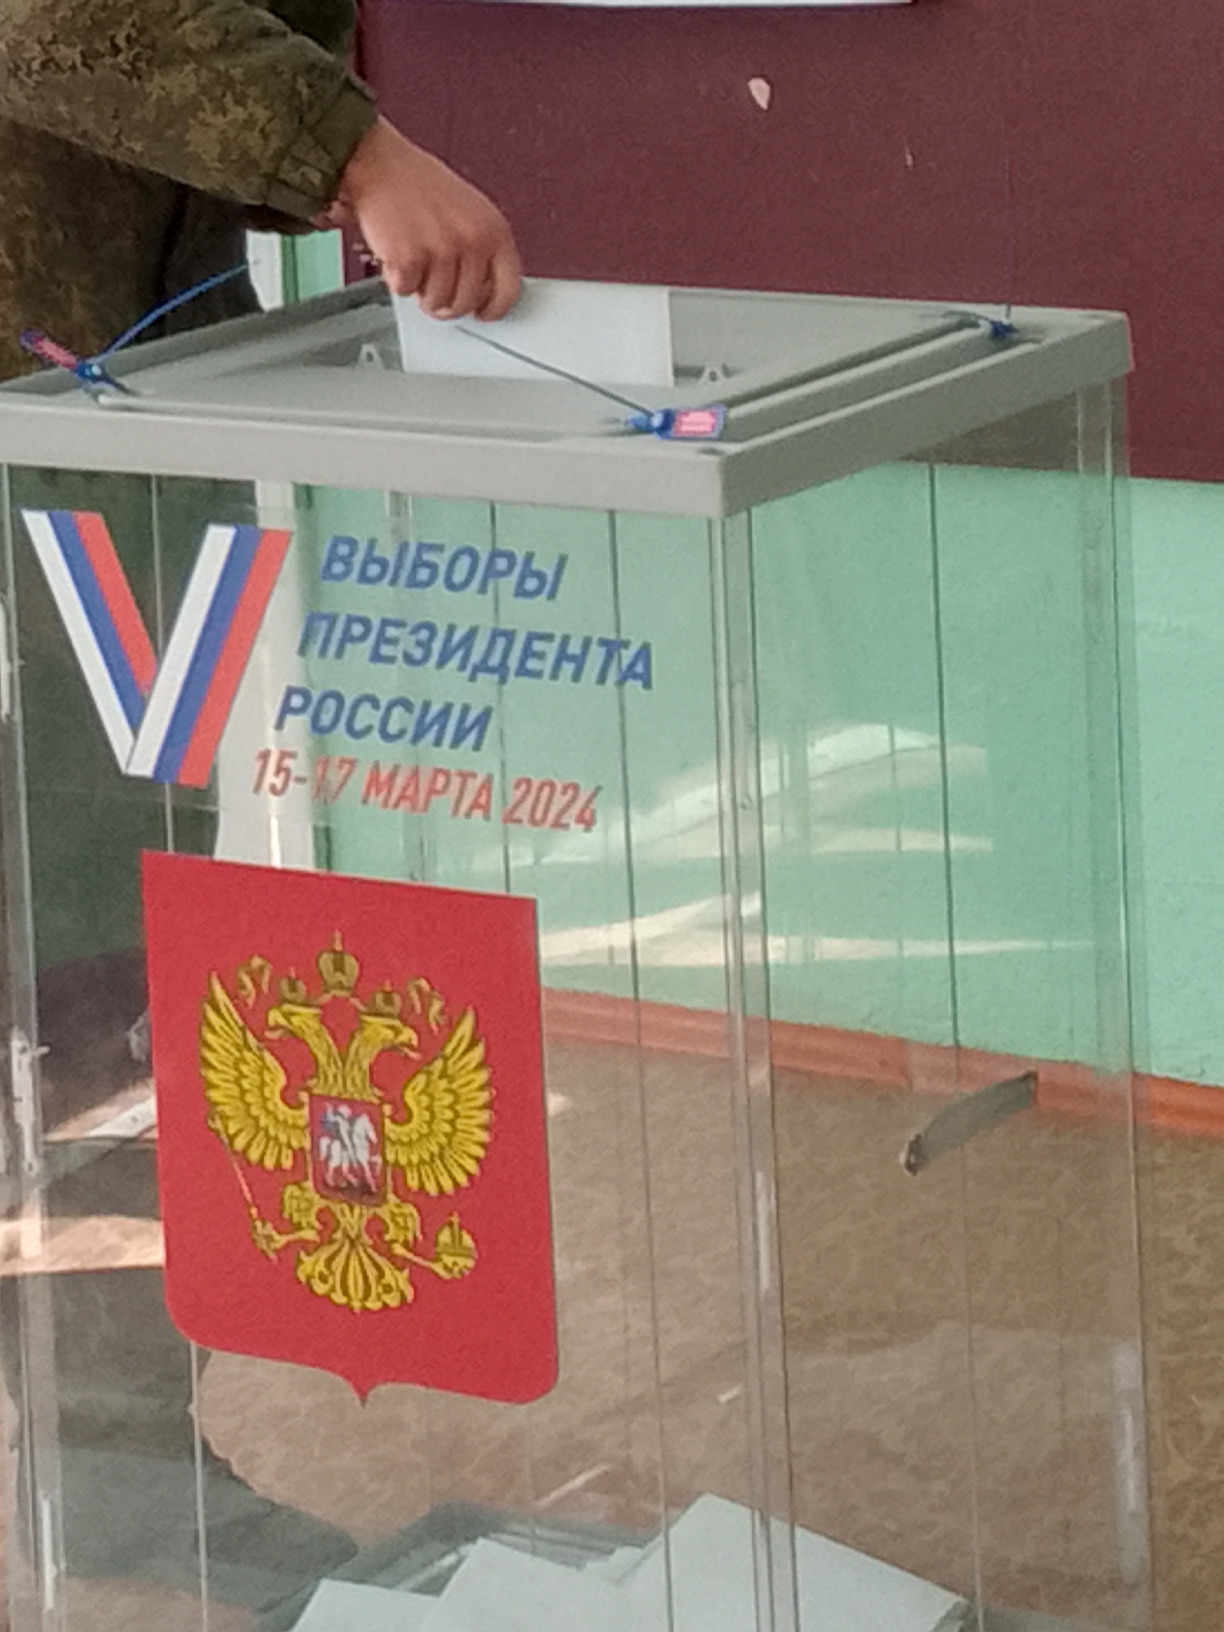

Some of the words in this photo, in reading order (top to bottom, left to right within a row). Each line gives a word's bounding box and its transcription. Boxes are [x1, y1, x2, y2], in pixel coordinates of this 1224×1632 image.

[320, 534, 568, 601] ВЫБОРЫ
[297, 610, 653, 691] ПРЕЗИДЕНТА
[274, 685, 494, 752] РОССИИ
[253, 747, 358, 804] 15-17
[361, 759, 495, 822] МАРТА
[501, 776, 603, 833] 2024
